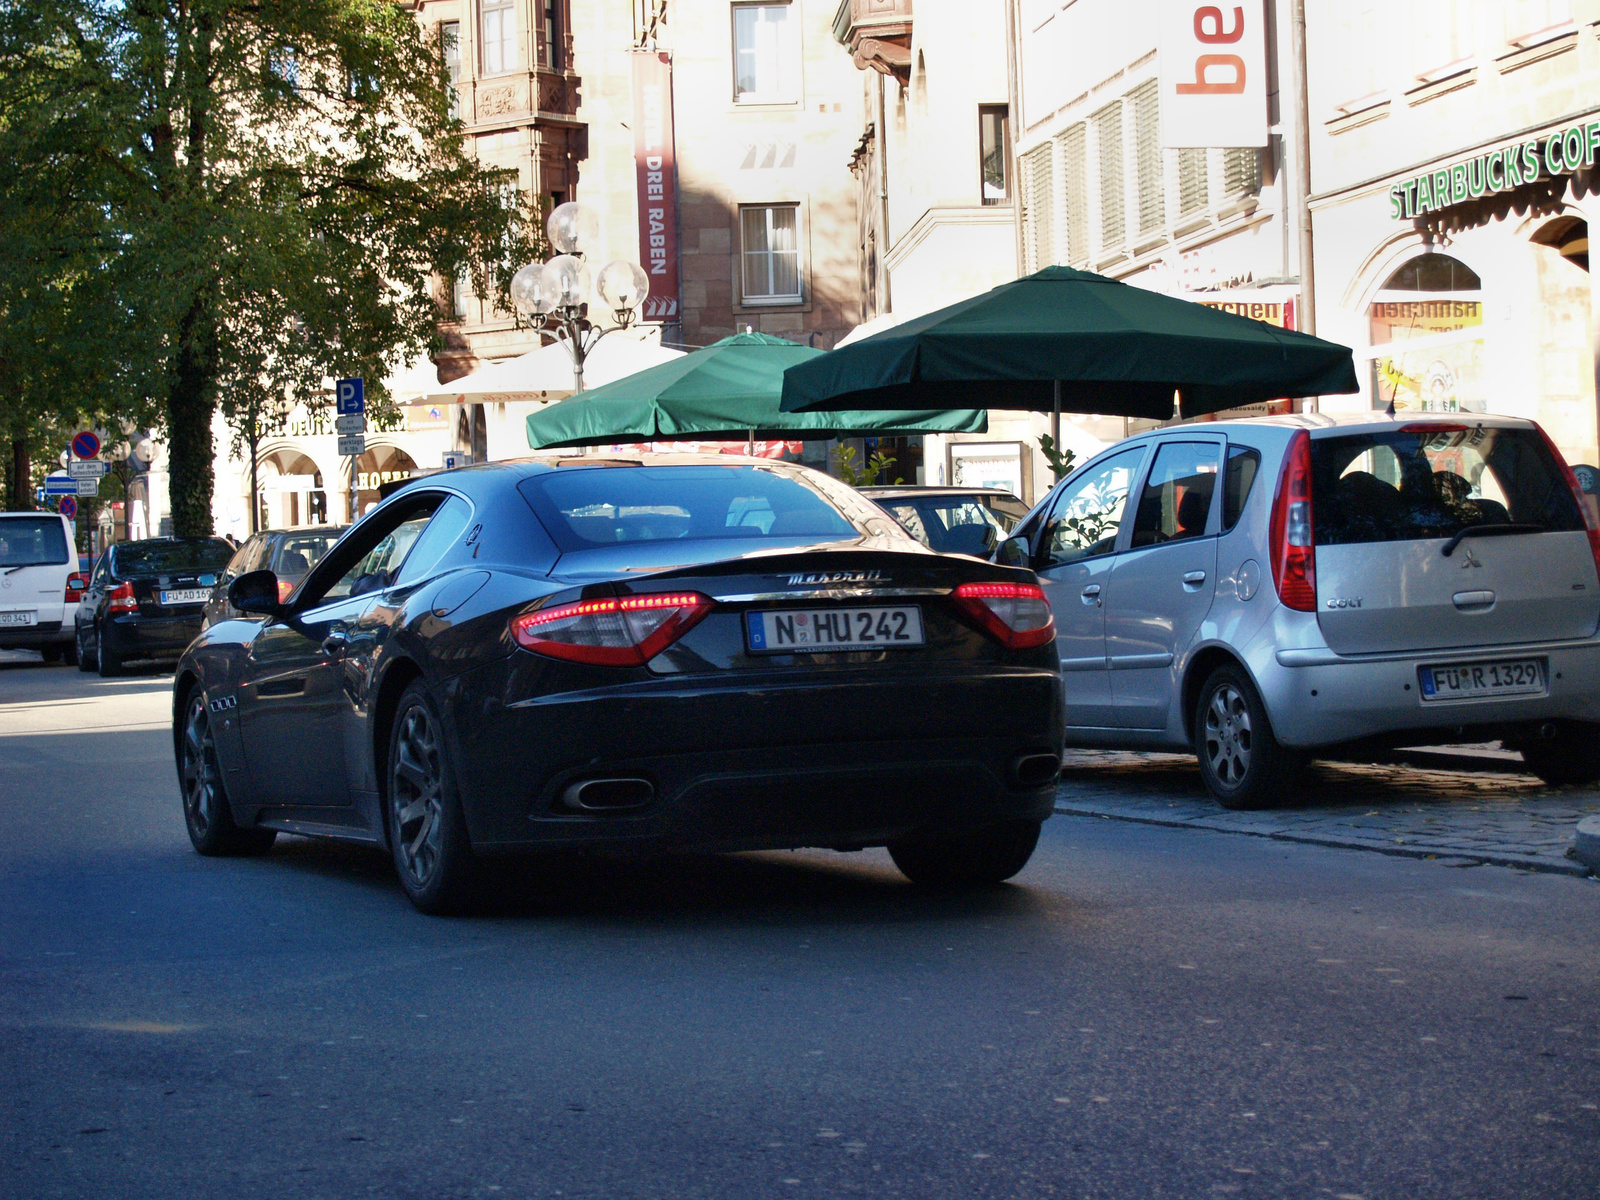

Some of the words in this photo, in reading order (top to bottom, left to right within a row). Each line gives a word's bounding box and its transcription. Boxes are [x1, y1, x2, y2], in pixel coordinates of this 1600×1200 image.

[646, 156, 663, 201] DREI
[1390, 141, 1540, 220] STARBUCKS
[1545, 122, 1600, 175] COF
[648, 208, 667, 274] RABEN
[340, 383, 355, 410] P
[776, 569, 892, 586] Maserati
[1326, 597, 1363, 609] COLT
[775, 615, 796, 644] N
[813, 613, 852, 643] HU
[857, 611, 910, 642] 242
[1434, 669, 1461, 692] FÜ
[1473, 667, 1486, 689] R
[1490, 664, 1537, 688] 1329
